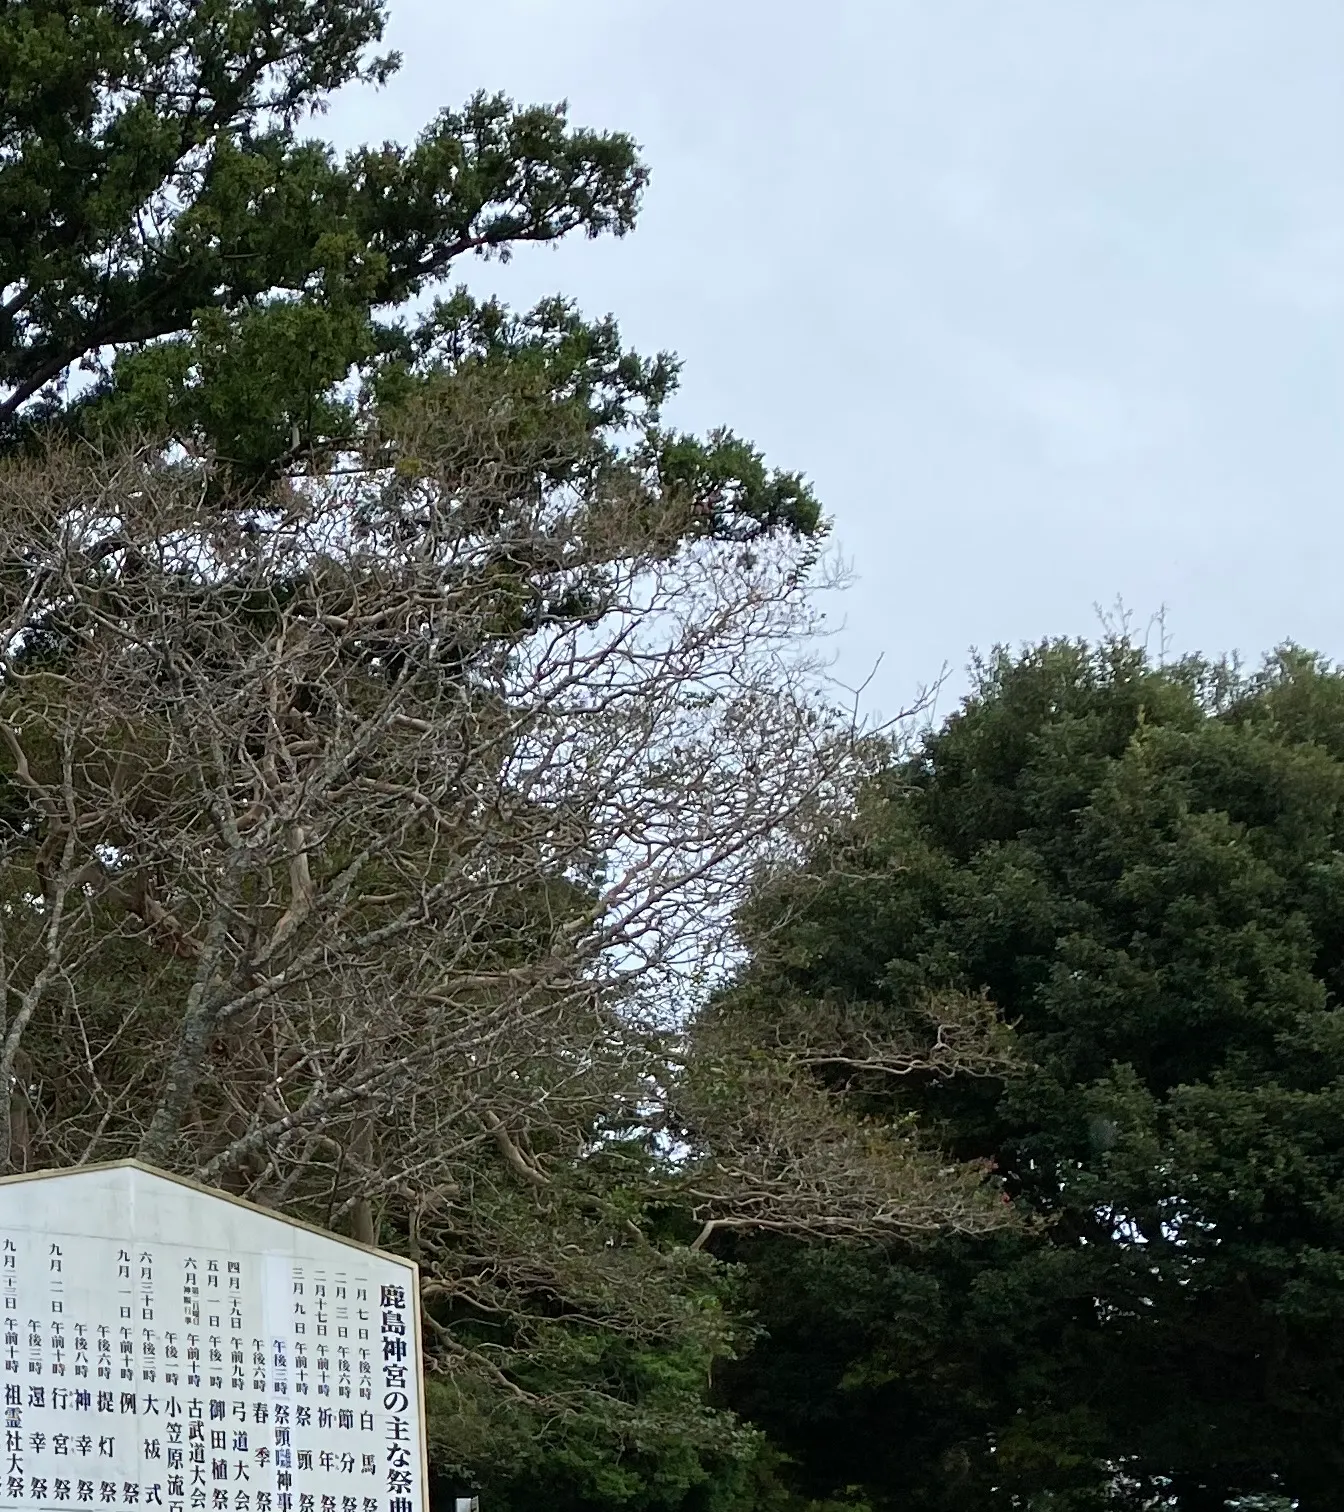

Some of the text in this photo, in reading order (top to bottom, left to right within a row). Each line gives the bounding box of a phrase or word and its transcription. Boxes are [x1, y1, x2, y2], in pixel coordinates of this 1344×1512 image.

[3, 1238, 18, 1310] 九月二十三日
[139, 1251, 154, 1321] 六月三十日
[184, 1257, 198, 1286] 六月
[206, 1259, 220, 1328] 五月一日
[227, 1260, 242, 1329] 四月二十九日
[292, 1267, 306, 1334] 三月九日
[314, 1270, 328, 1337] 二月十七日
[334, 1272, 349, 1339] 二月三日
[355, 1278, 370, 1340] 一月七日
[4, 1317, 19, 1373] 午前十時
[27, 1319, 43, 1375] 午後三時
[49, 1243, 71, 1500] 九月二日 午前十時 行宮祭
[117, 1249, 139, 1504] 九月一日 午前十時 例祭
[142, 1327, 157, 1383] 午後三時
[164, 1331, 179, 1386] 午後一時
[186, 1333, 201, 1388] 午前十時
[208, 1335, 223, 1389] 午後一時
[230, 1336, 245, 1391] 午前九時
[273, 1339, 288, 1395] 午後三時
[294, 1342, 309, 1395] 午前十時
[316, 1343, 330, 1397] 午前十時
[337, 1345, 351, 1399] 午後六時
[358, 1347, 372, 1400] 午後六時
[73, 1322, 94, 1502] 午後八時 神幸祭
[96, 1324, 117, 1503] 午後六時 提灯祭
[252, 1338, 272, 1512] 午後六時 春季祭
[187, 1397, 206, 1509] 古武道大会
[210, 1399, 228, 1510] 御田植祭
[232, 1401, 251, 1512] 弓道大会
